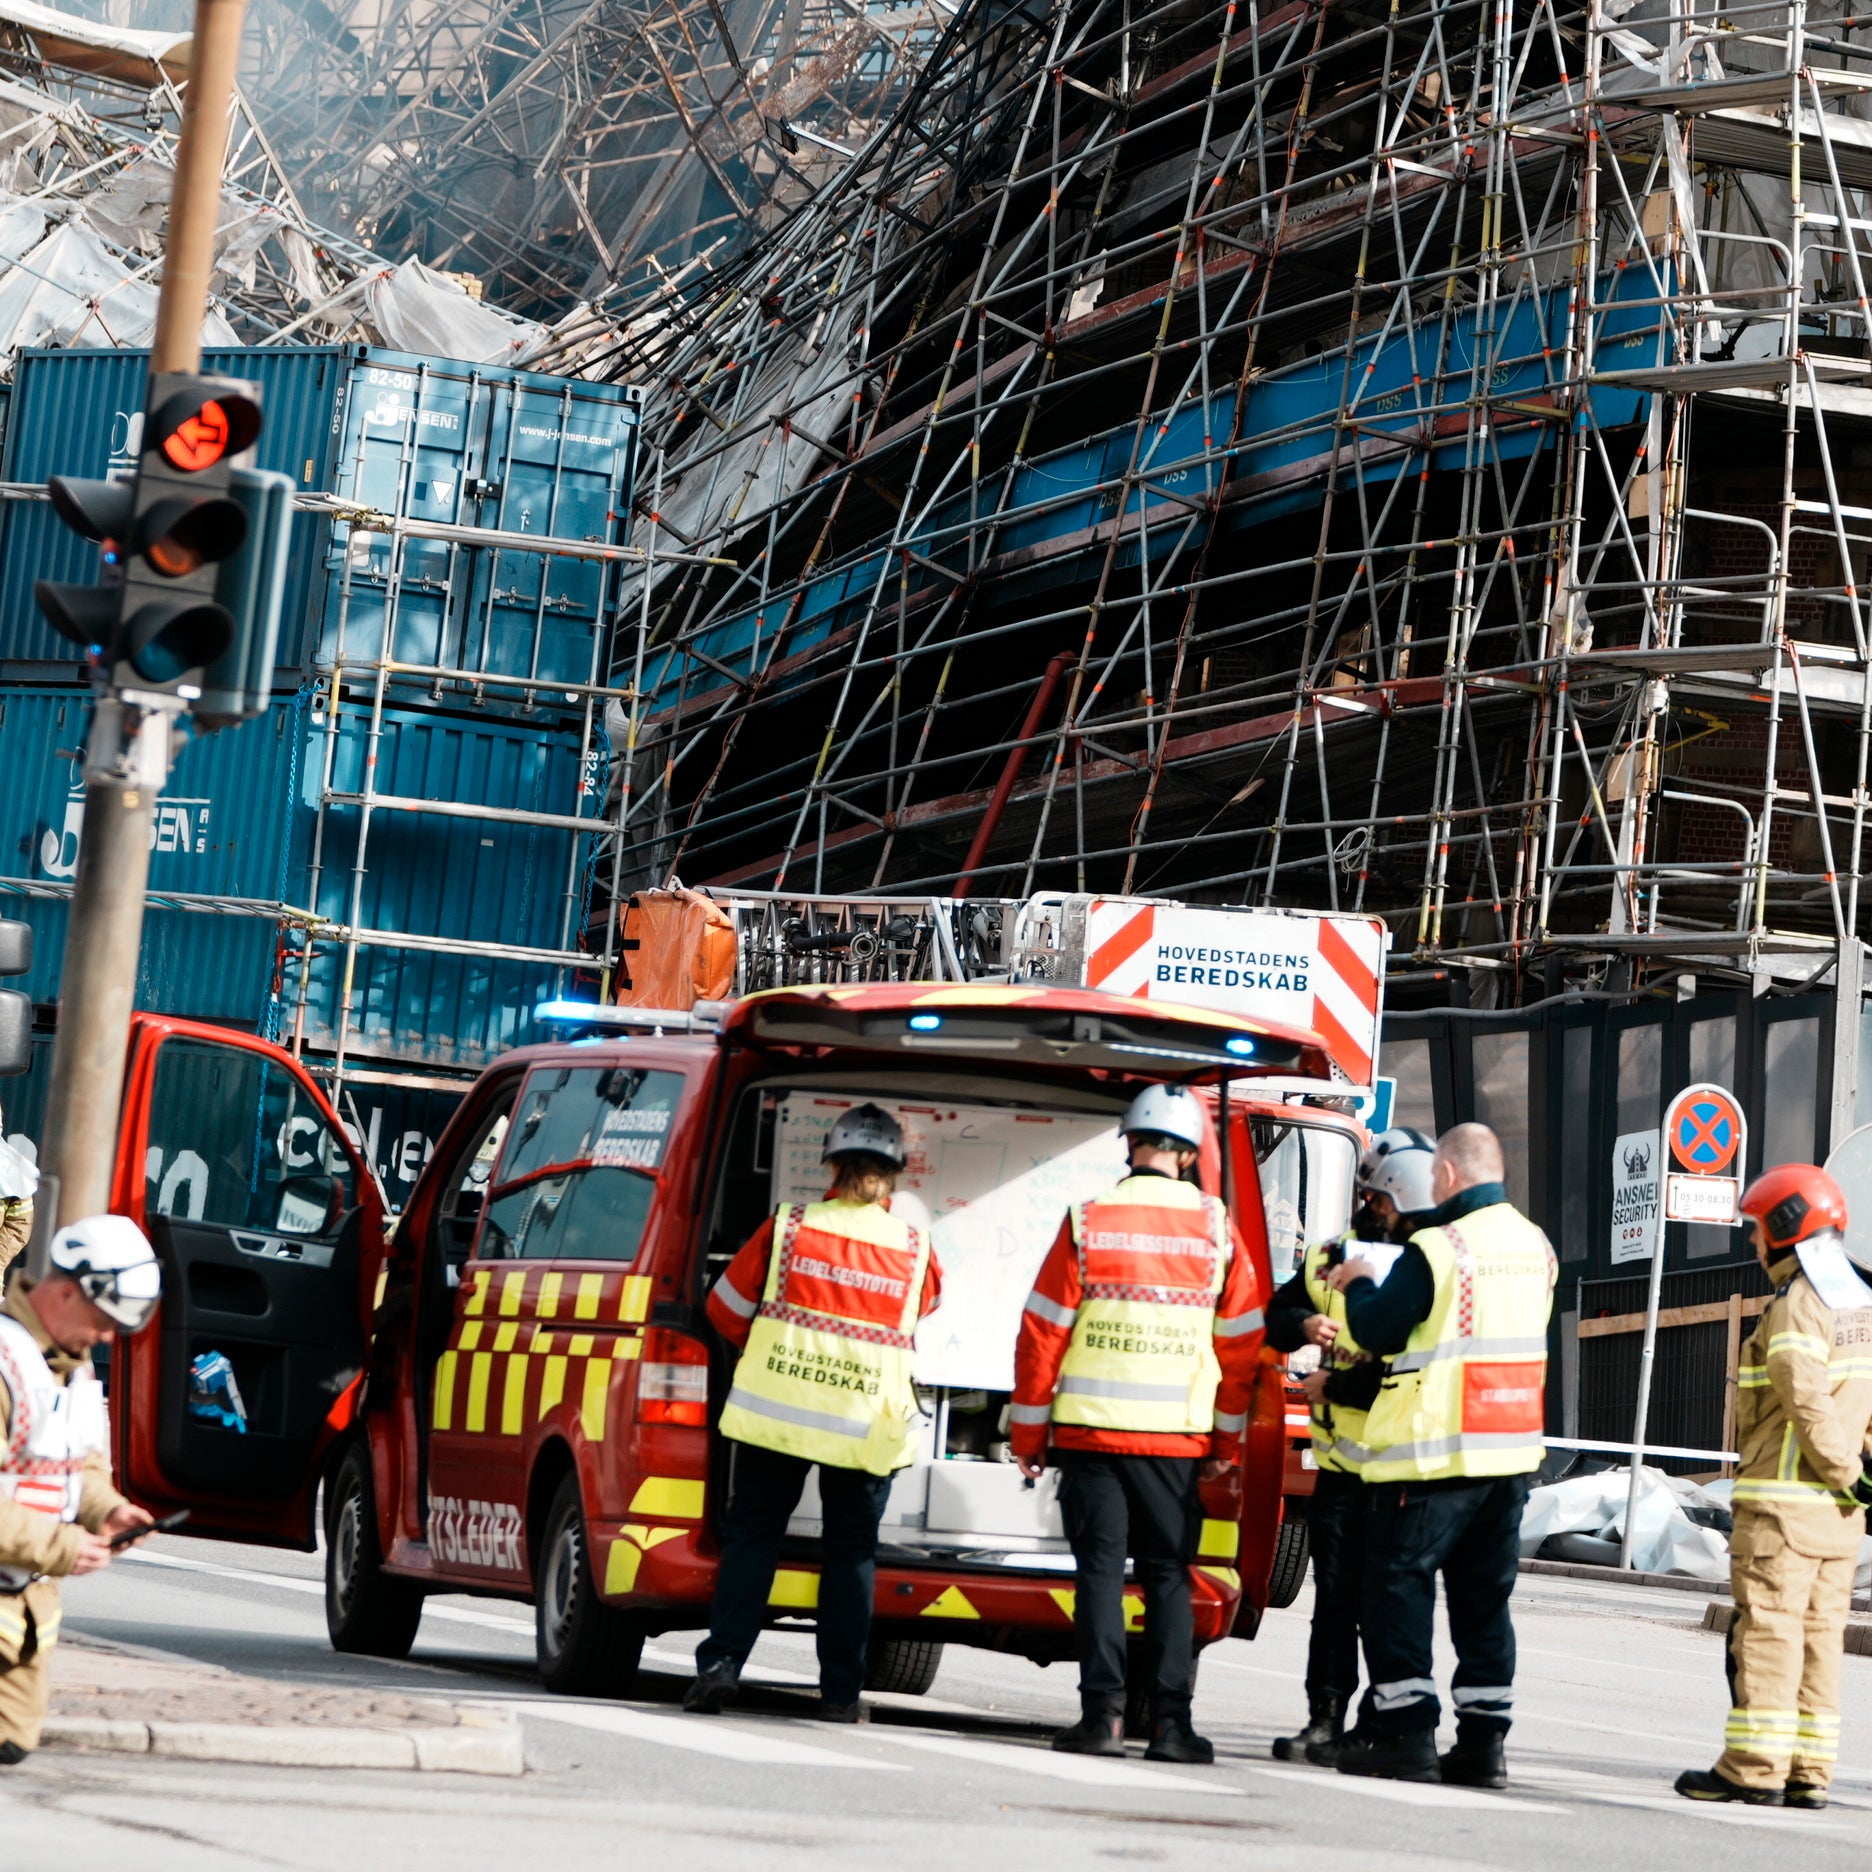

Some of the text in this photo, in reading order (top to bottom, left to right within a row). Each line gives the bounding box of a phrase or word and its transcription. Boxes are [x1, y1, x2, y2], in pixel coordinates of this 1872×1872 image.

[368, 368, 413, 390] 82-50
[332, 386, 345, 435] 82-50
[583, 750, 600, 797] 82-84
[1158, 944, 1310, 969] HOVEDSTADENS
[1156, 963, 1309, 992] BEREDSKAB
[1613, 1202, 1658, 1227] SECURITY
[790, 1252, 909, 1299] LEDELSESSTØTTE
[771, 1341, 883, 1379] HOVEDSTADENS
[1085, 1334, 1196, 1357] BEREDSKAB
[766, 1356, 880, 1395] BEREDSKAB
